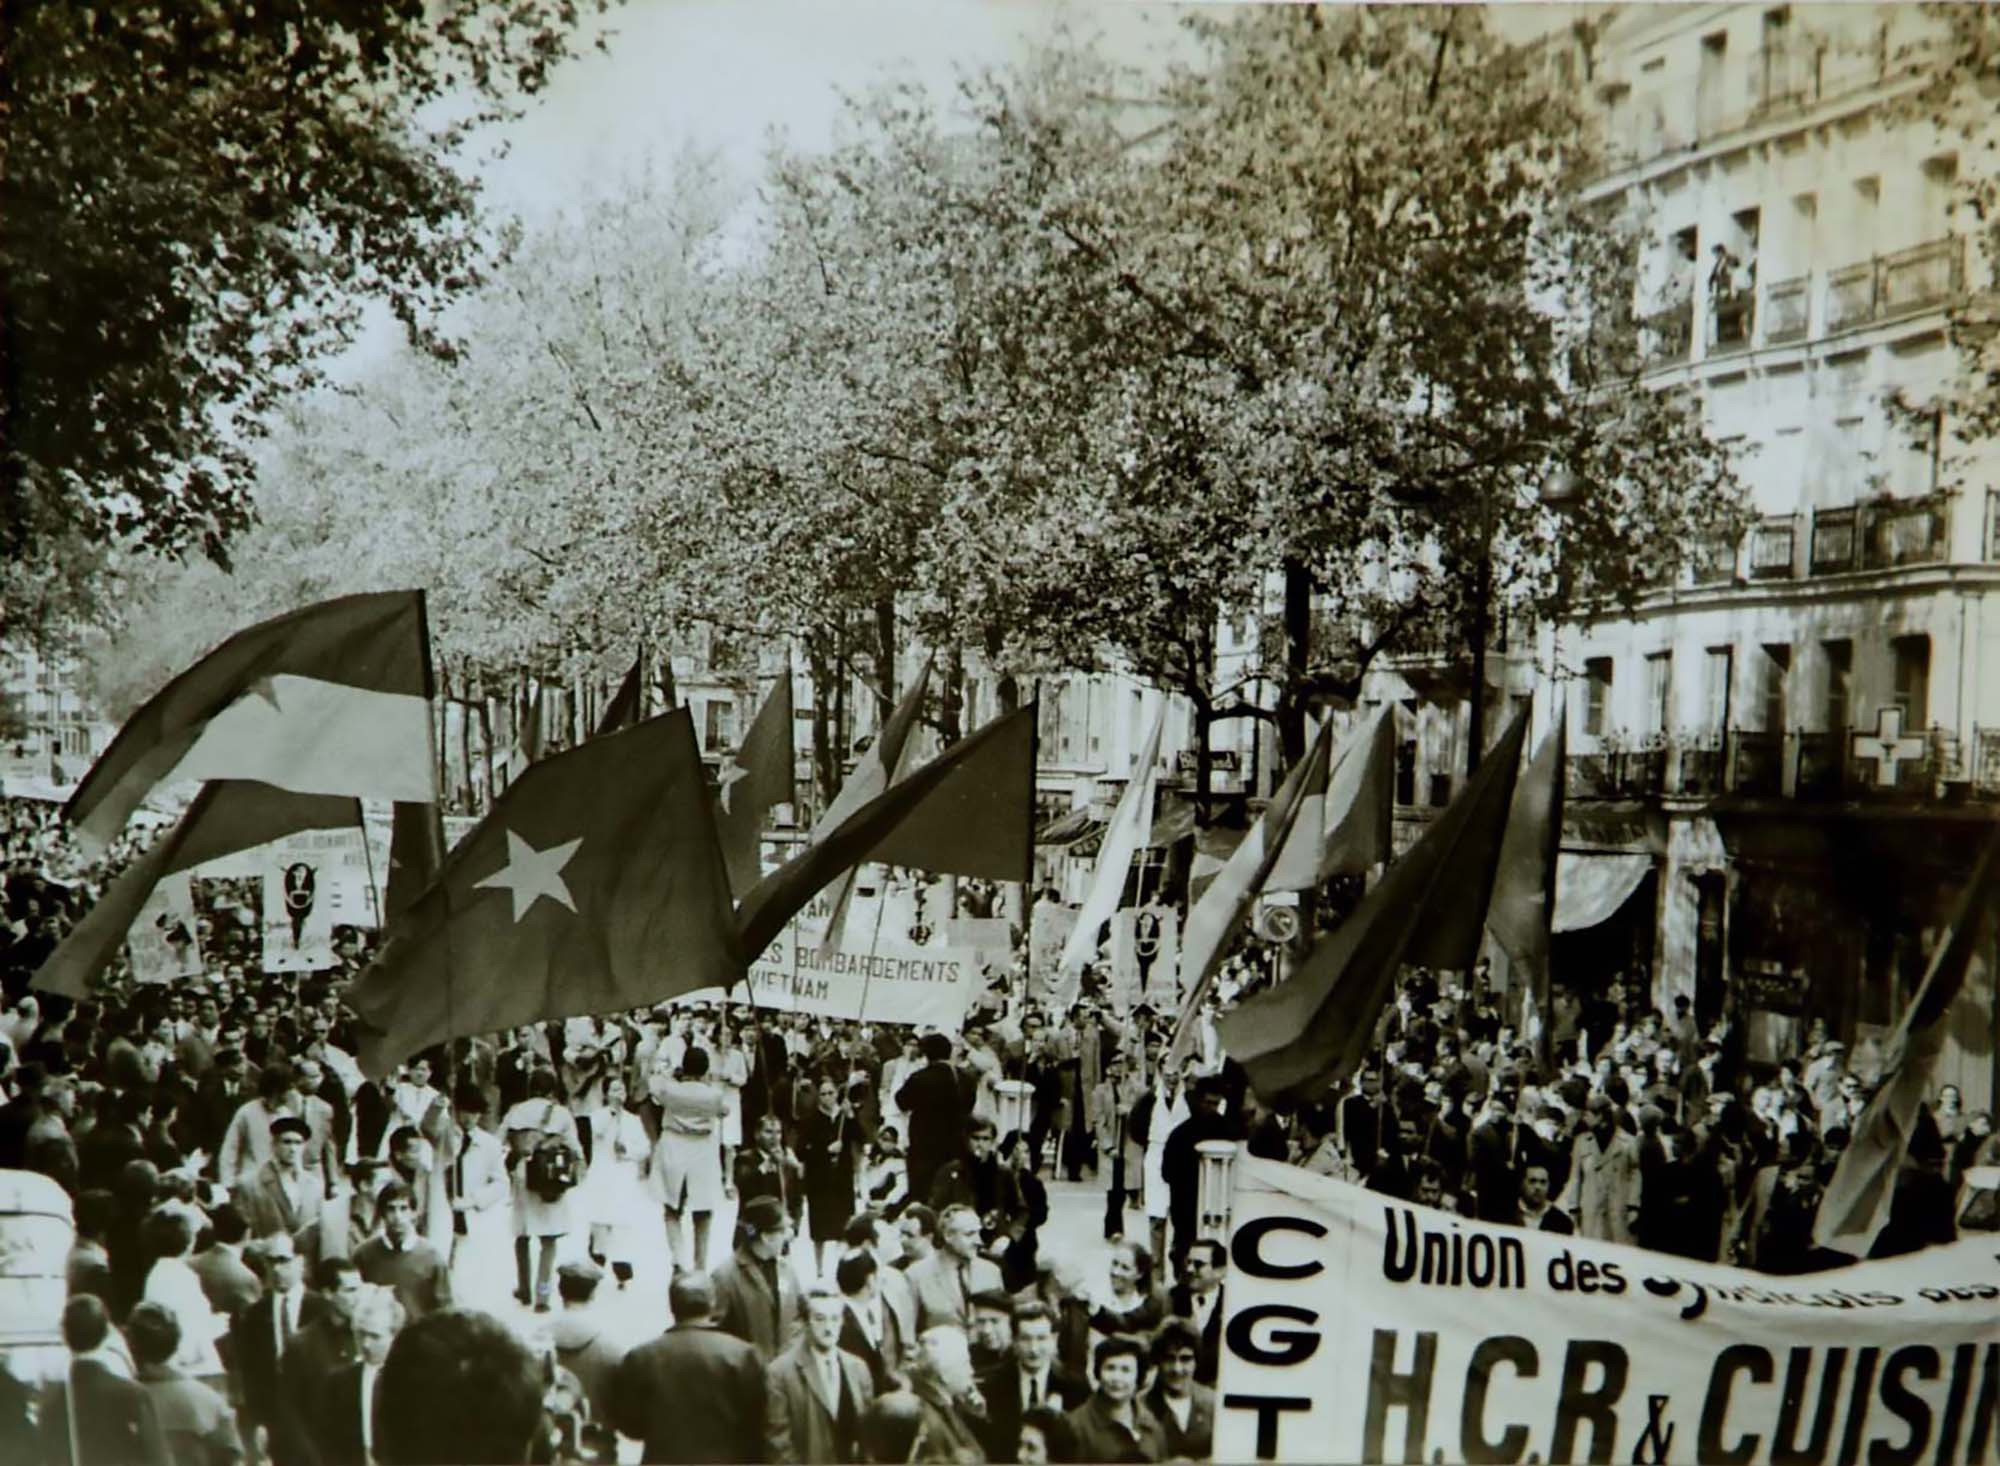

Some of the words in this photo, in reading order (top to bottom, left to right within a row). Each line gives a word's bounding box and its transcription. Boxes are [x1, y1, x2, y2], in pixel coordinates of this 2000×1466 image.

[796, 946, 960, 983] BOMBARDEMENTS
[1383, 1206, 1526, 1289] Union
[1547, 1248, 1627, 1295] des
[1632, 1394, 1675, 1465] &
